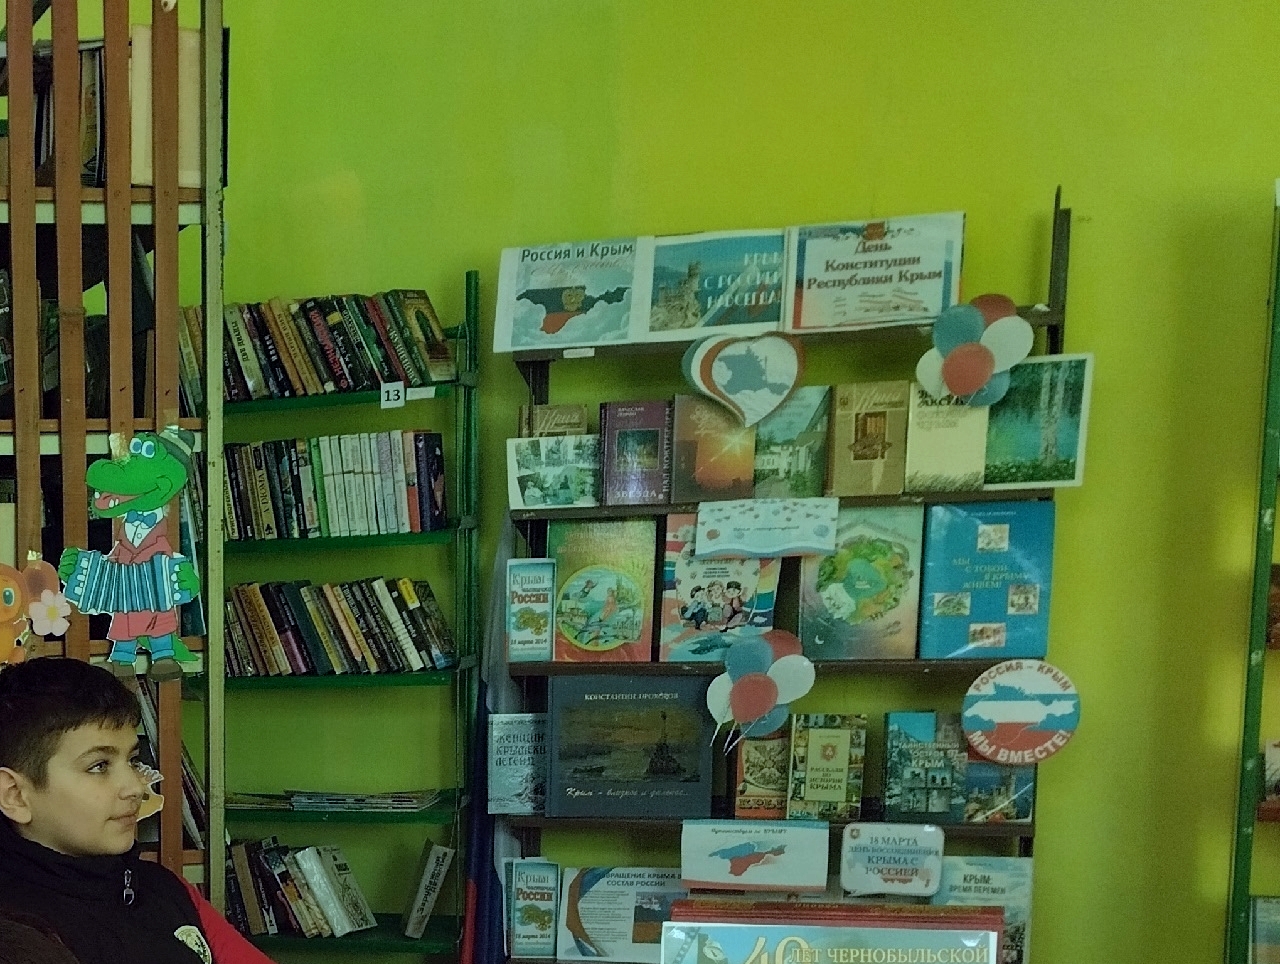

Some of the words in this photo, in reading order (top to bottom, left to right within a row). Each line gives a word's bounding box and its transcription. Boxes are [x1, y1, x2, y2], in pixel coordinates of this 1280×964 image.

[521, 247, 571, 263] Россия
[577, 247, 585, 258] и
[590, 242, 634, 260] Крым
[824, 255, 921, 273] Конституции
[807, 273, 893, 290] Республики
[384, 389, 401, 402] 13
[973, 661, 1024, 692] РОССИЯ
[1037, 663, 1072, 692] КРЫМ
[495, 733, 546, 744] ЖЕНЩИН
[495, 745, 546, 756] КРЫМСКИ
[968, 730, 997, 757] МЫ
[997, 729, 1072, 763] ВМЕСТЕ!
[912, 759, 945, 768] КРЫМ
[870, 837, 879, 845] 18
[882, 836, 918, 846] МАРТА
[867, 856, 908, 865] КРЫМА
[865, 866, 920, 877] РОССИЕЙ
[606, 879, 634, 887] СОСТАВ
[963, 873, 993, 885] КРЫМ:
[515, 888, 554, 901] России
[788, 948, 823, 964] ЛЕТ
[827, 945, 989, 964] ЧЕРНОБЫЛЬСКОЙ
